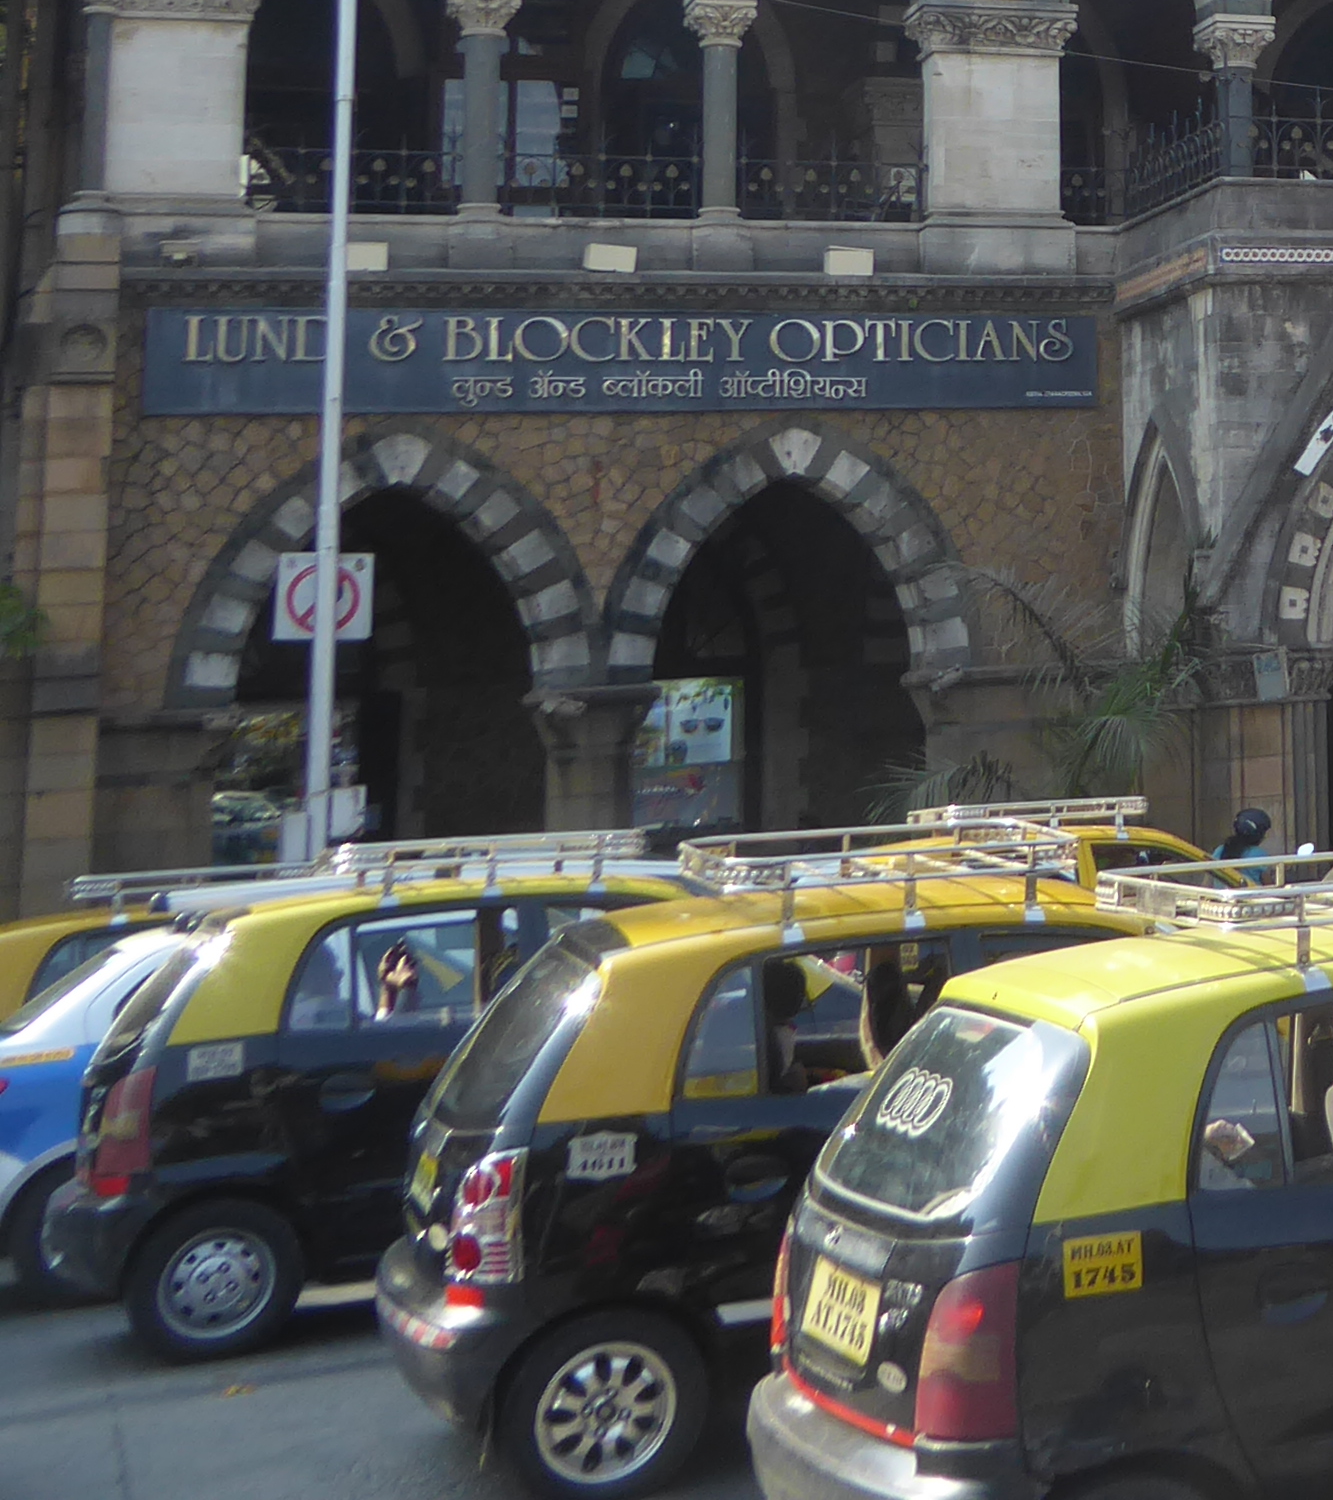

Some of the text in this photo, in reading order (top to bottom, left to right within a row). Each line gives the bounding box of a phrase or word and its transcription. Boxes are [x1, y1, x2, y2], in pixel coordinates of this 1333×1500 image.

[182, 315, 1075, 364] LUND & BLOCKLEY OPTICIANS
[1073, 1263, 1137, 1289] 1745
